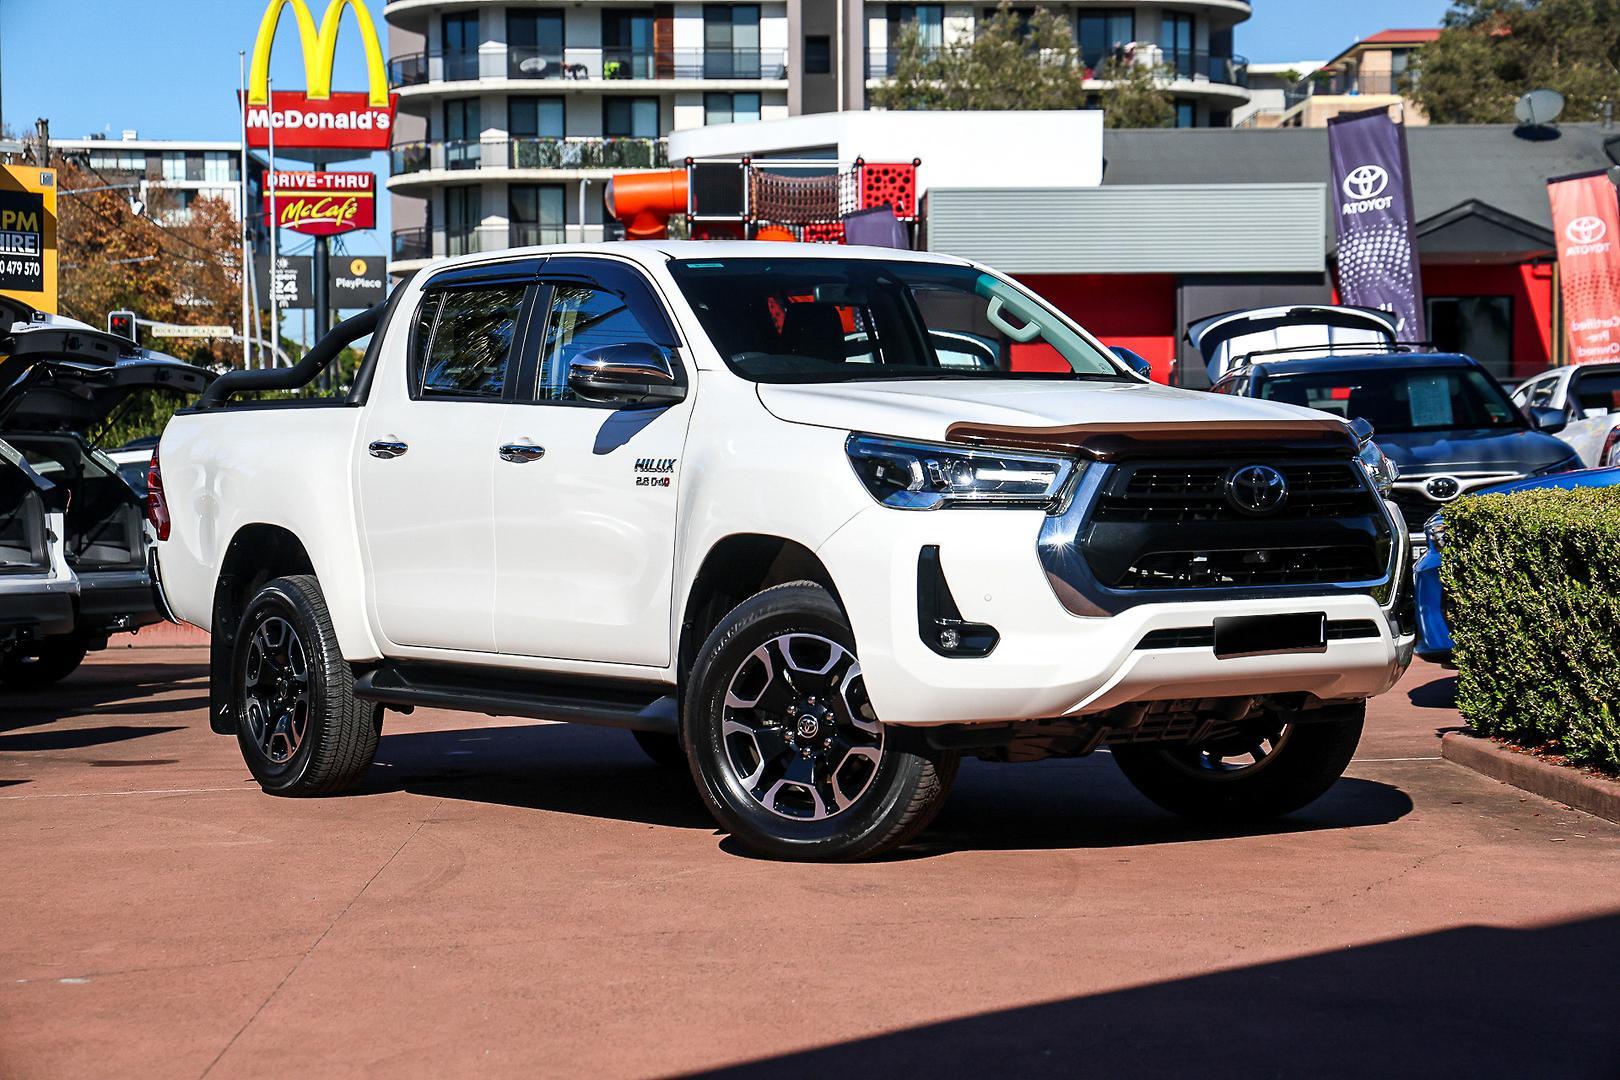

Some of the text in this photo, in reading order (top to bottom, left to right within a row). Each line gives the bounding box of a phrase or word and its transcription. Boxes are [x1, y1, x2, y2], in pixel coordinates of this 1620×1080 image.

[246, 109, 390, 130] McDonald's
[267, 174, 369, 188] DRIVE-THRU
[0, 210, 39, 232] PM
[6, 260, 23, 275] 479
[24, 262, 40, 277] 570
[335, 277, 382, 289] PlayPlace
[634, 458, 678, 473] HILUX
